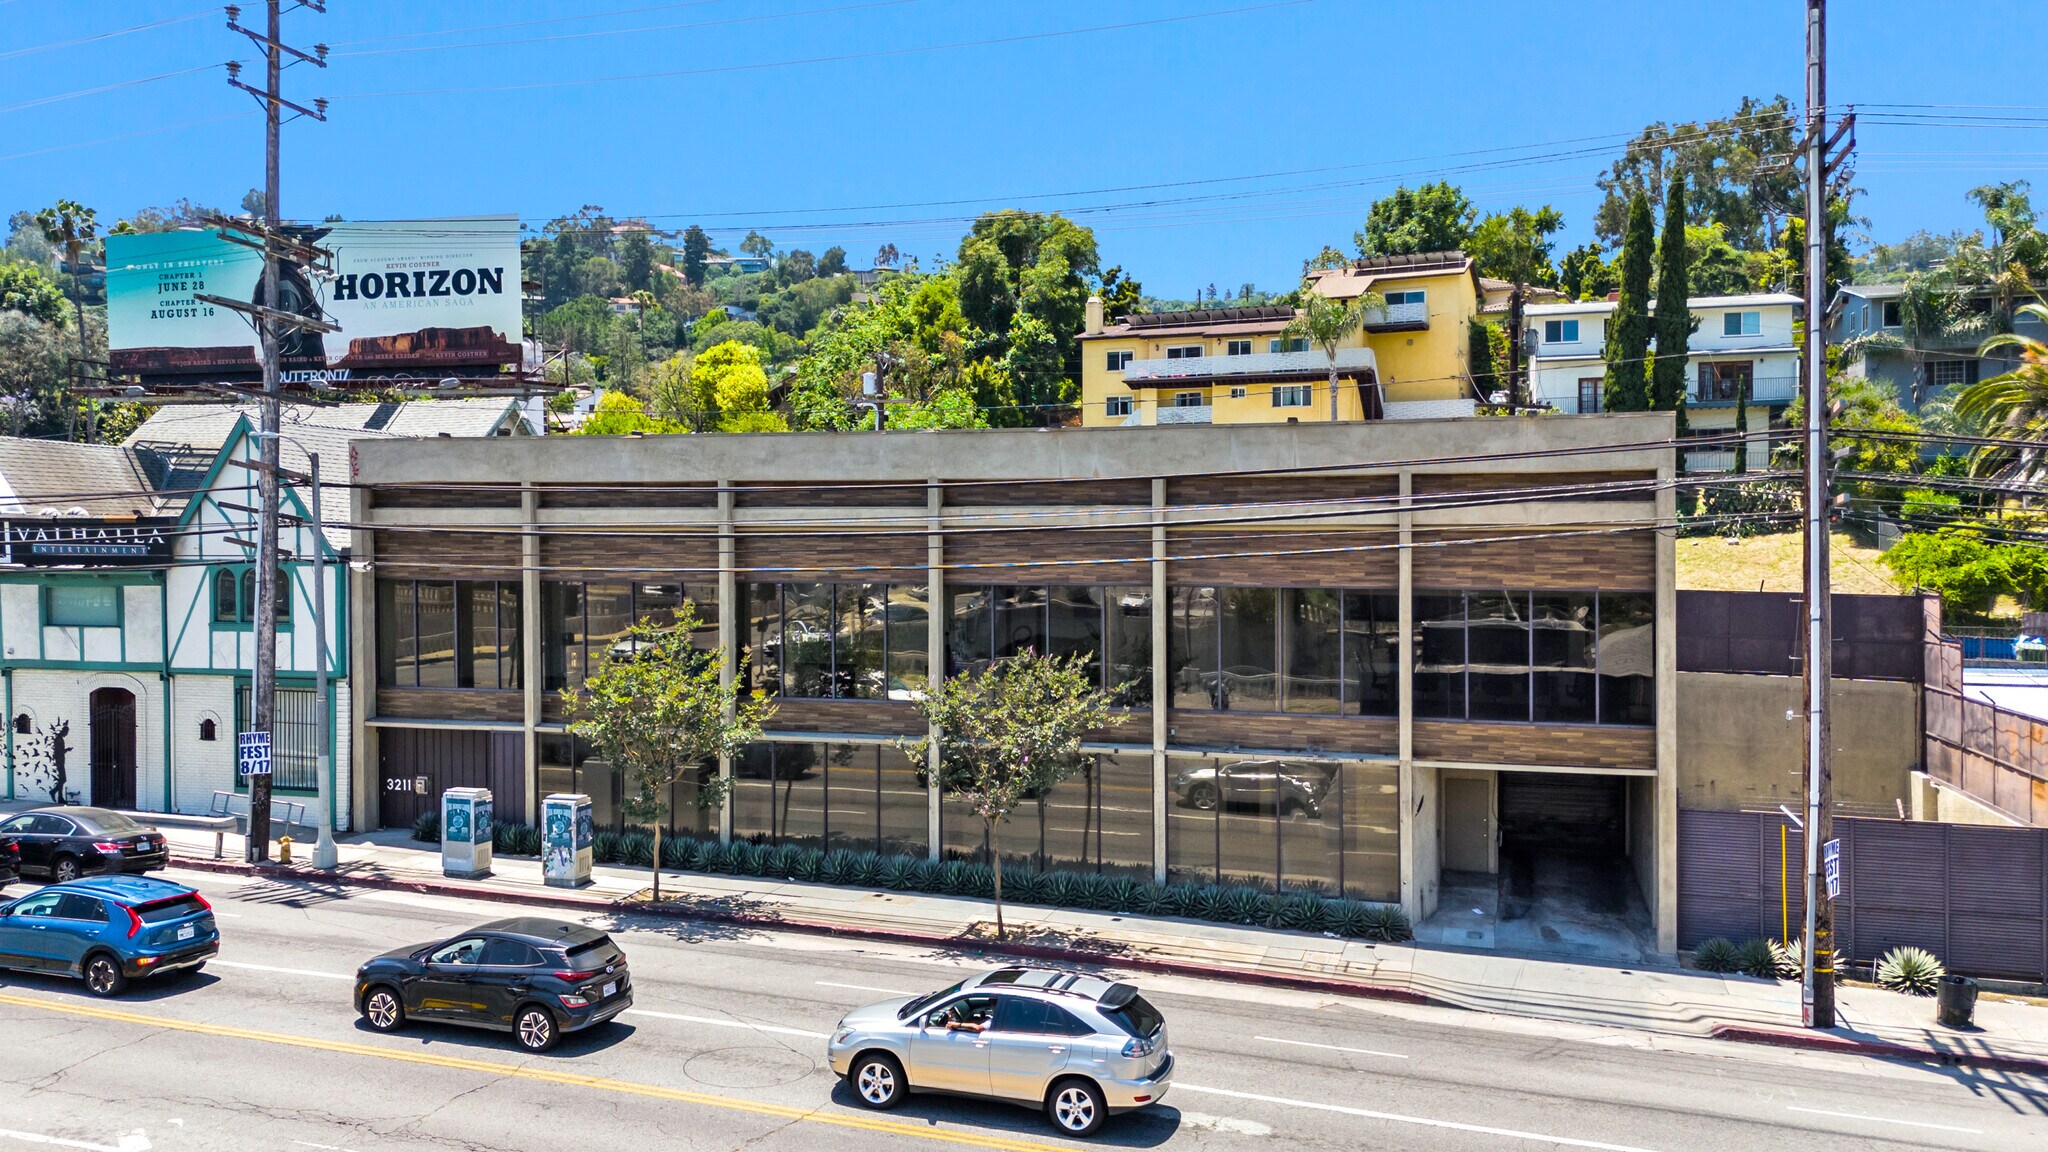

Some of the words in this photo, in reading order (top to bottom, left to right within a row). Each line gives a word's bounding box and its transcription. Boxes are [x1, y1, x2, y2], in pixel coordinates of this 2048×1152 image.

[136, 262, 159, 270] ONLY
[163, 261, 174, 269] IN
[177, 259, 224, 268] THEATERS
[158, 272, 195, 280] CHAPTER
[158, 281, 188, 294] JUNE
[192, 281, 205, 290] 28
[333, 267, 504, 301] HORIZON
[159, 299, 196, 307] CHAPTER
[363, 302, 377, 310] AN
[382, 298, 440, 309] AMERICAN
[445, 297, 475, 307] SAGA
[151, 308, 198, 319] AUGUST
[203, 307, 215, 317] 16
[14, 526, 165, 544] VALHALLA
[33, 546, 147, 554] ENTERTAINMENT
[240, 733, 270, 745] RHYME
[240, 745, 270, 759] FEST
[241, 760, 270, 774] 8/17
[386, 778, 411, 791] 3211
